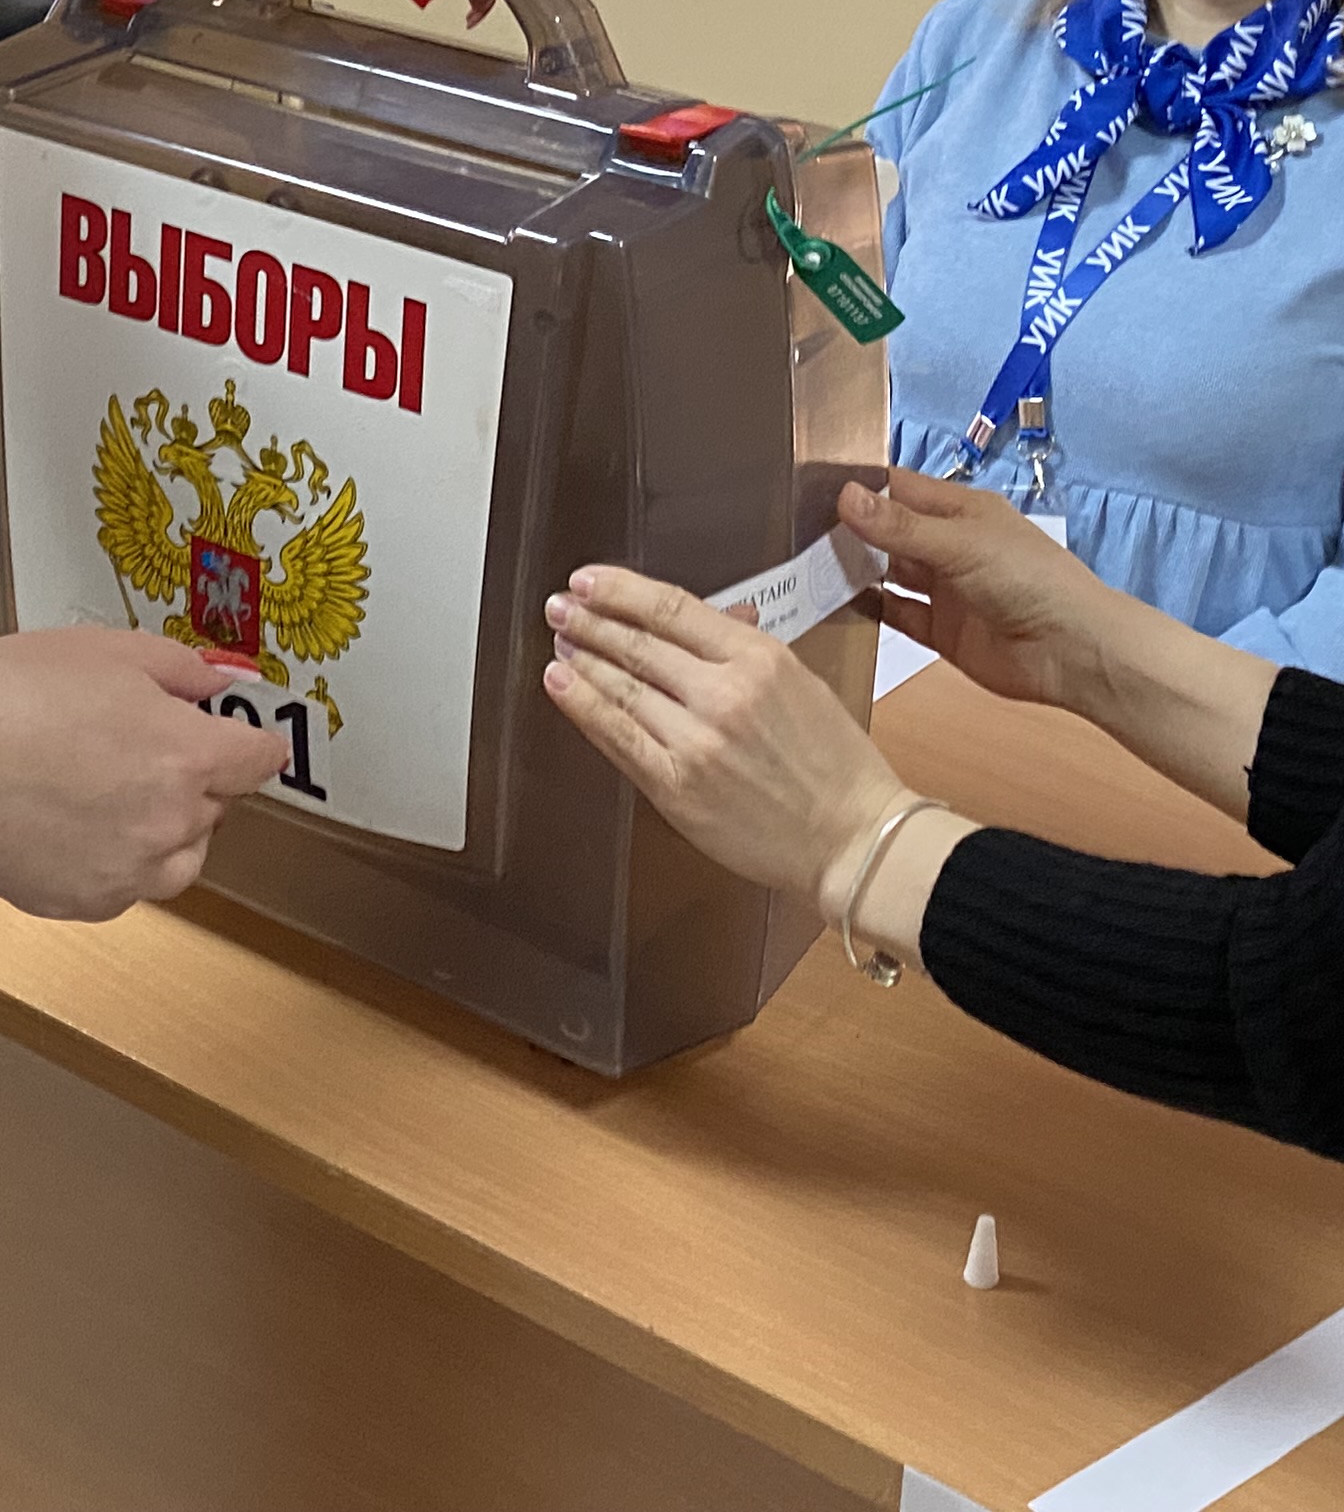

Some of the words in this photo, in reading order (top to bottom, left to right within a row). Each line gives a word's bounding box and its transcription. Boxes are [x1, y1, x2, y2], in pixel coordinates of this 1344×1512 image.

[1209, 20, 1264, 91] УИК
[1249, 40, 1298, 101] УИК
[1022, 144, 1091, 201] УИК
[1198, 150, 1253, 212] УИК
[1085, 215, 1151, 273] УИК
[59, 192, 428, 415] ВЫБОРЫ
[1021, 286, 1083, 355] УИК
